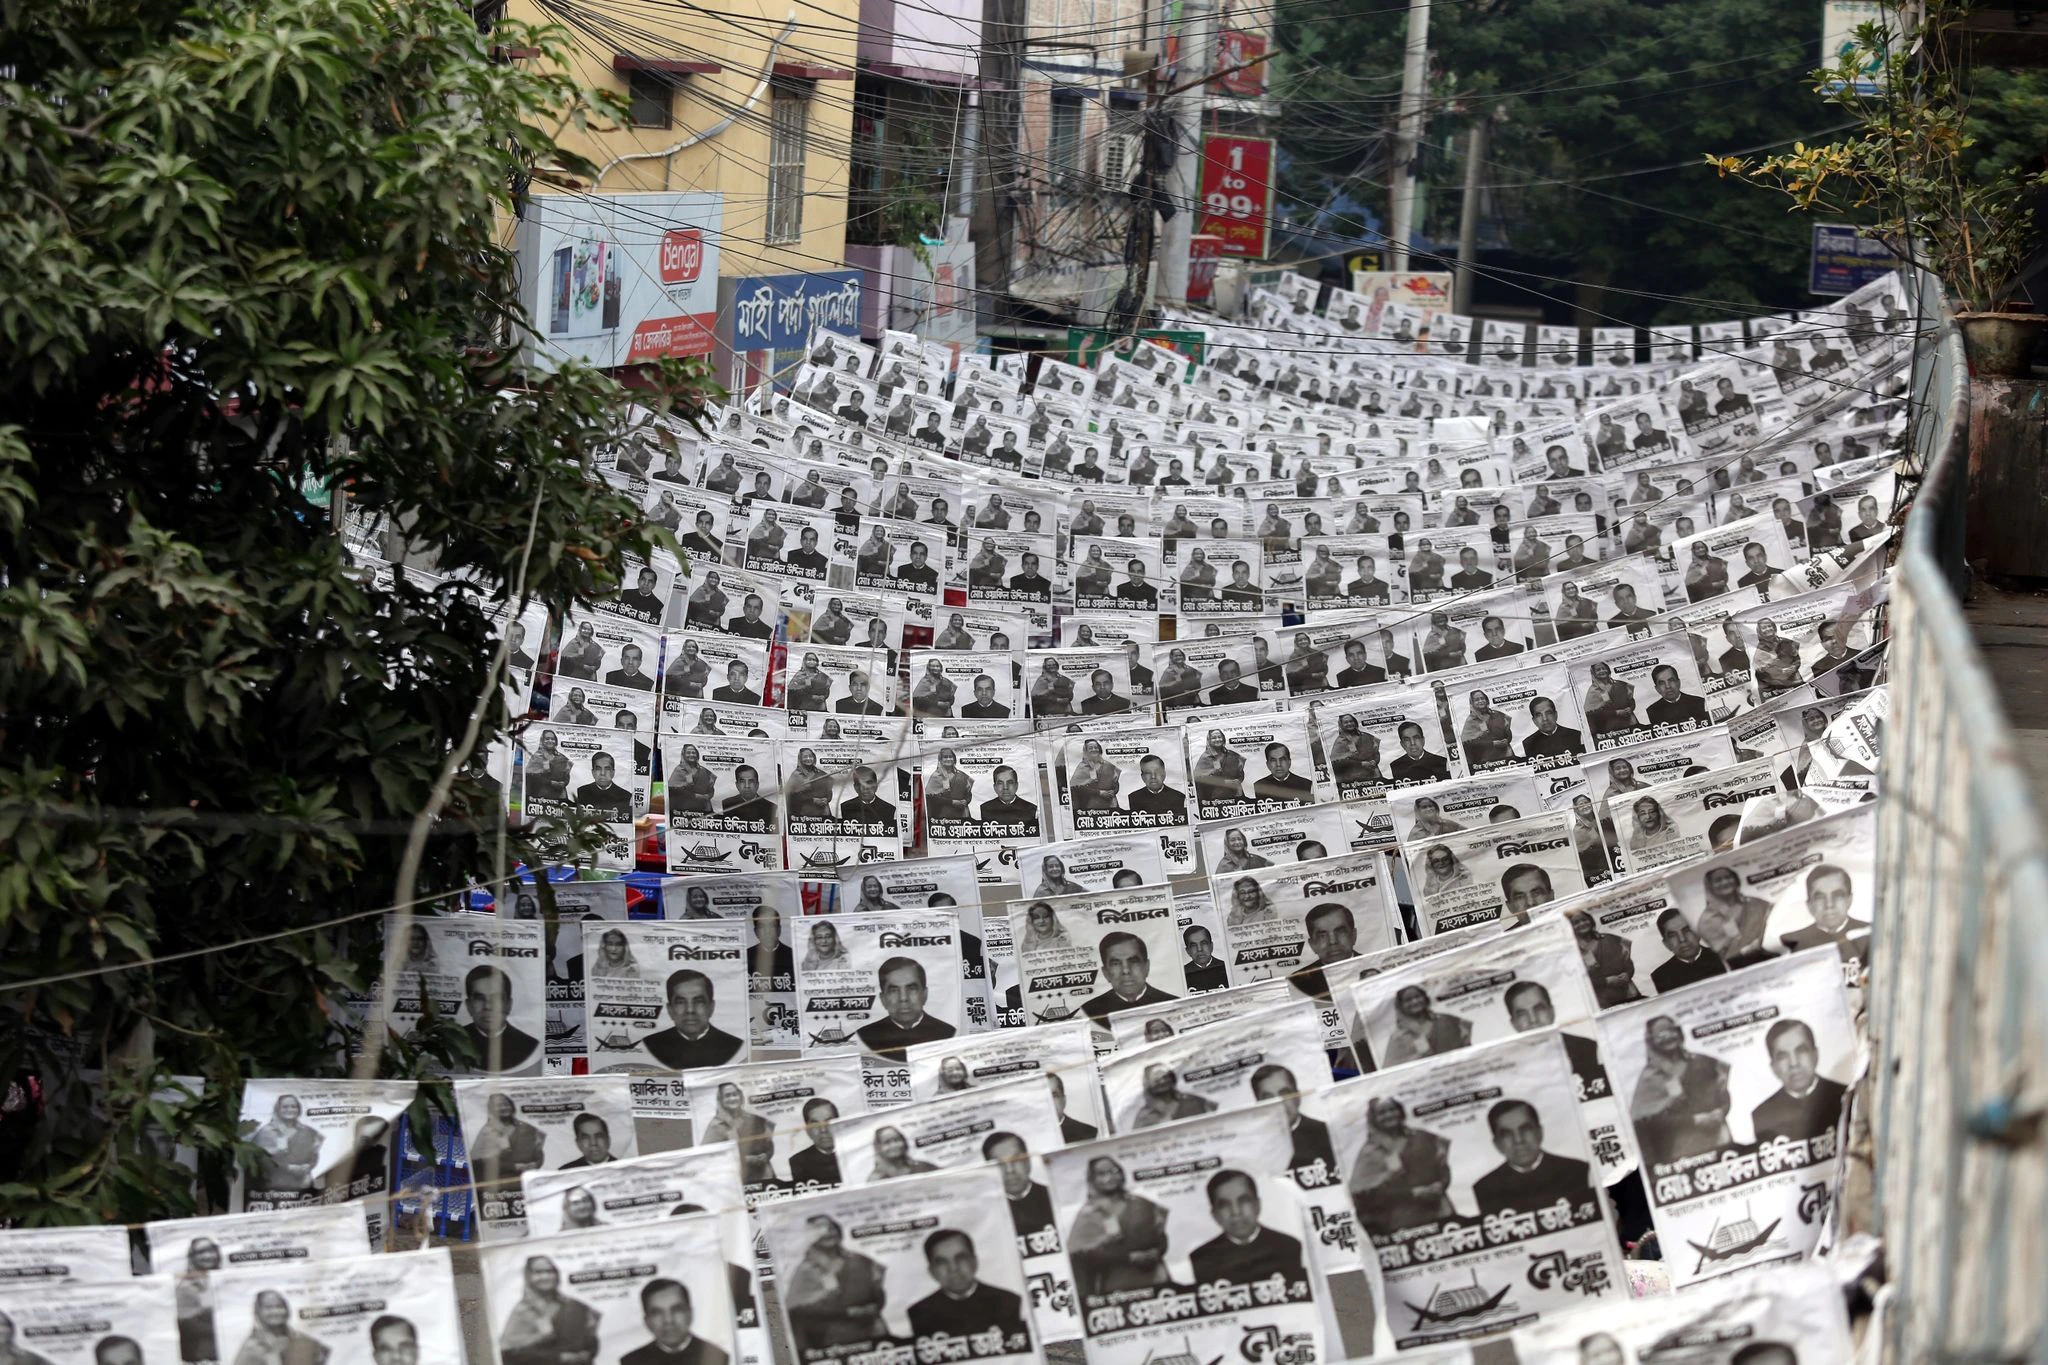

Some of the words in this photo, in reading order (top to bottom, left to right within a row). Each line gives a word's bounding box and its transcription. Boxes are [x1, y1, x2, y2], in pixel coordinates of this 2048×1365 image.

[1230, 146, 1243, 171] 1
[1223, 176, 1246, 189] to
[664, 237, 699, 277] Bengal
[738, 286, 774, 341] মাহী
[778, 278, 806, 335] পর্দা
[1653, 722, 1679, 740] উদ্দিন
[1674, 789, 1698, 800] আসন্ন
[1723, 776, 1749, 789] জাতীয়
[528, 803, 543, 815] মোঃ
[1202, 806, 1219, 818] মোঃ
[1221, 801, 1256, 818] ওয়াকিল
[672, 816, 689, 828] মোঃ
[690, 815, 722, 831] ওয়াকিল
[724, 816, 748, 832] উদ্দিন
[790, 823, 807, 834] মোঃ
[843, 820, 866, 835] উদ্দিন
[1077, 816, 1094, 829] মোঃ
[1096, 811, 1130, 829] ওয়াকিল
[1131, 811, 1156, 827] উদ্দিন
[931, 825, 946, 837] মোঃ
[948, 821, 981, 838] ওয়াকিল
[982, 821, 1007, 837] উদ্দিন
[1165, 847, 1188, 859] ভোট
[1496, 837, 1571, 859] নির্বাচনে
[1303, 877, 1377, 898] নির্বাচনে
[1097, 908, 1169, 924] নির্বাচনে
[1440, 915, 1468, 930] সংসদ
[1471, 908, 1498, 923] সদস্য
[469, 940, 538, 958] নির্বাচনে
[880, 932, 952, 949] নির্বাচনে
[668, 945, 740, 961] নির্বাচনে
[1240, 948, 1270, 961] সংসদ
[1272, 944, 1299, 957] সদস্য
[1033, 976, 1063, 990] সংসদ
[1065, 973, 1093, 985] সদস্য
[600, 1005, 628, 1017] সংসদ
[630, 1007, 656, 1017] সদস্য
[812, 998, 840, 1010] সংসদ
[843, 997, 870, 1009] সদস্য
[635, 1095, 670, 1107] মার্কায়
[1656, 1174, 1692, 1202] মোঃ
[1694, 1150, 1760, 1192] ওয়াকিল
[1759, 1135, 1810, 1172] উদ্দিন
[483, 1198, 511, 1219] মোঃ
[1414, 1222, 1483, 1260] ওয়াকিল
[1483, 1208, 1538, 1243] উদ্দিন
[1087, 1307, 1125, 1334] মোঃ
[1128, 1288, 1199, 1325] ওয়াকিল
[1198, 1278, 1252, 1313] উদ্দিন
